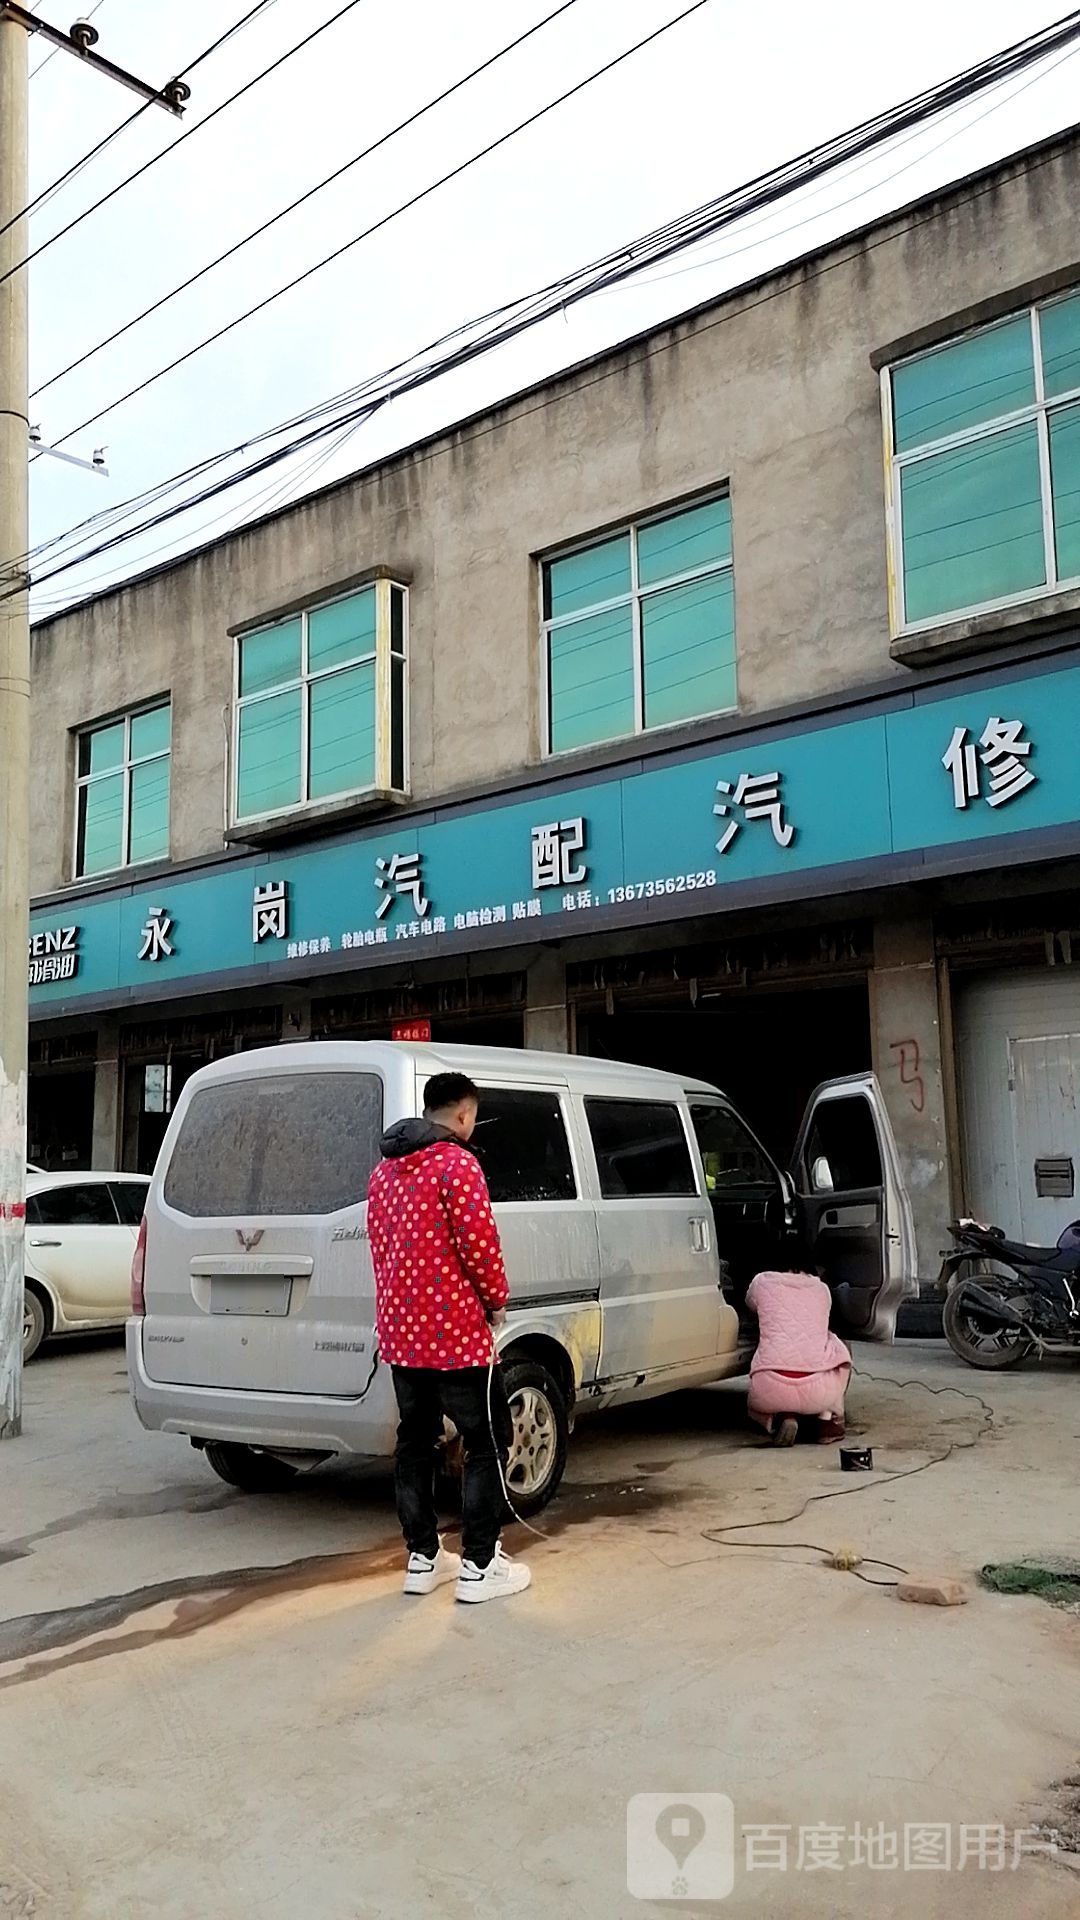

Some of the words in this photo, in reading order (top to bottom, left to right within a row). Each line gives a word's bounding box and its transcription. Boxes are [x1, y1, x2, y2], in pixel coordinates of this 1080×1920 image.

[287, 936, 332, 959] 维修保养
[341, 927, 387, 949] 轮胎电瓶
[395, 916, 446, 940] 汽车电路
[453, 904, 507, 930] 电脑检测
[512, 898, 542, 921] 贴膜
[607, 869, 717, 904] 13673562528
